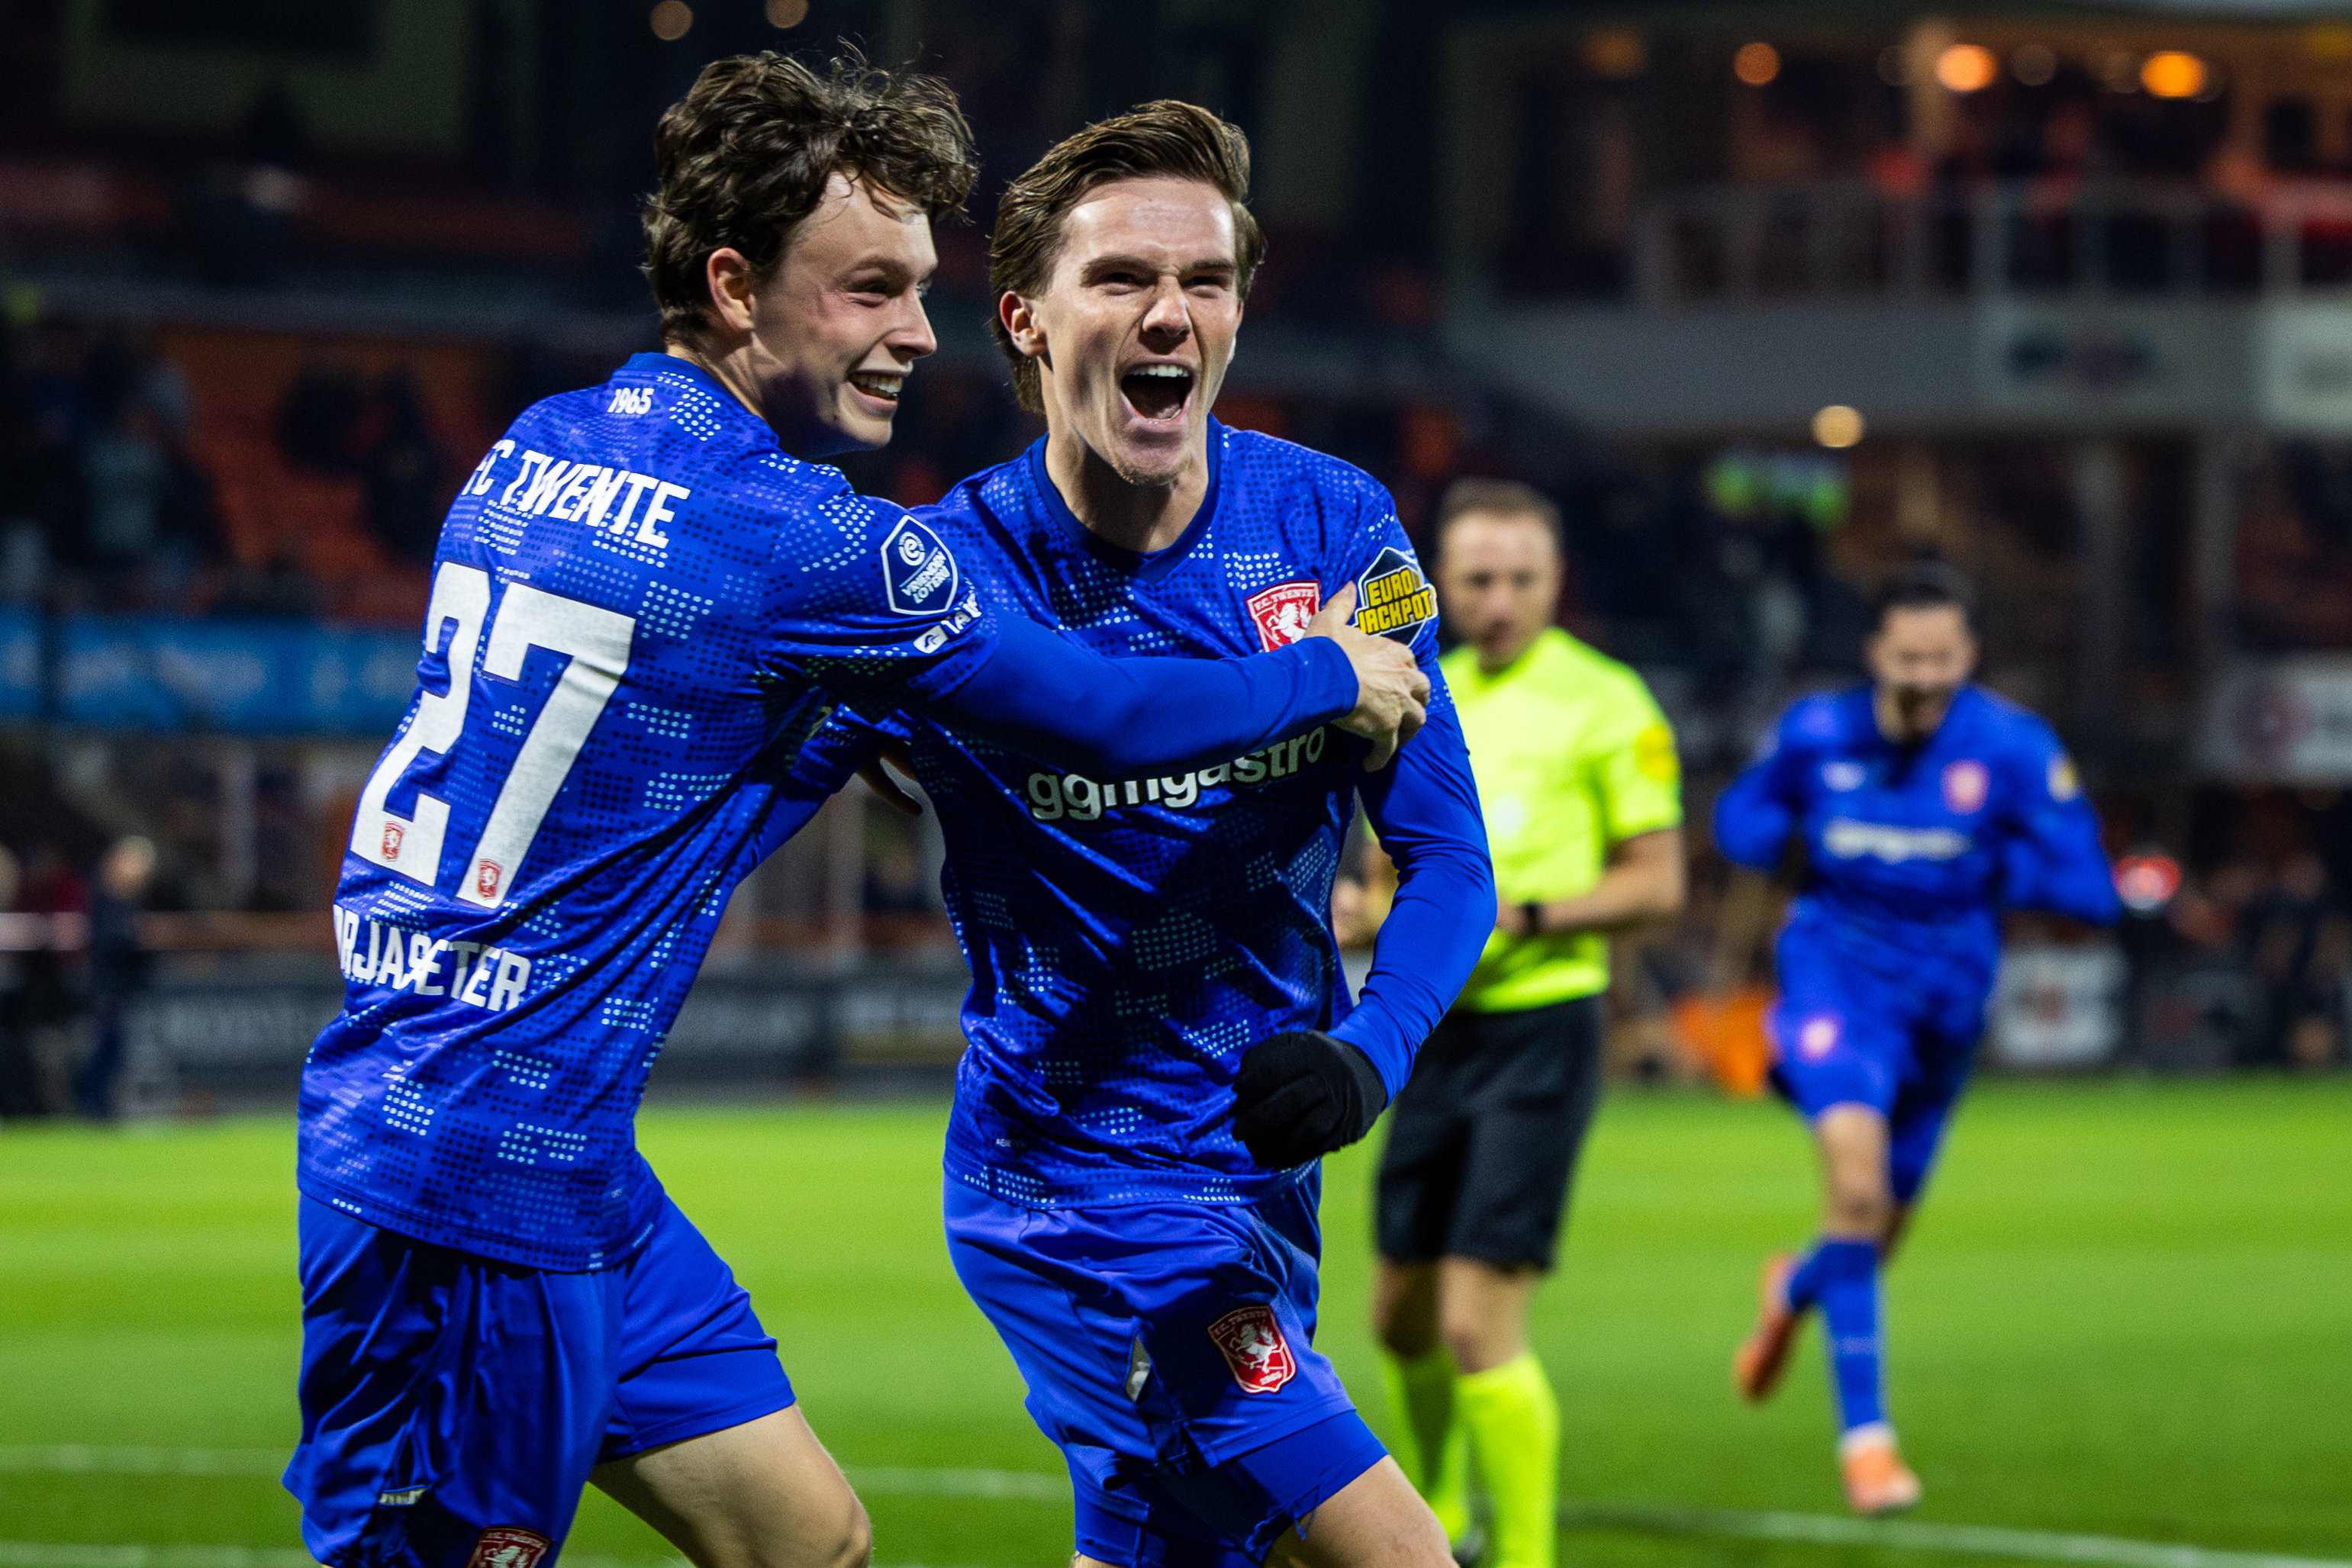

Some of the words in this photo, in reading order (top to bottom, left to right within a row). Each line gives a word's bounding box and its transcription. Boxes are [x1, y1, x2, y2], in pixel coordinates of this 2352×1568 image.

[607, 388, 654, 414] 1965
[500, 449, 691, 549] TWENTE
[1270, 588, 1315, 603] TWENTE
[1367, 568, 1413, 607] EURO
[1358, 591, 1432, 633] JACKPOT
[350, 561, 636, 910] 27
